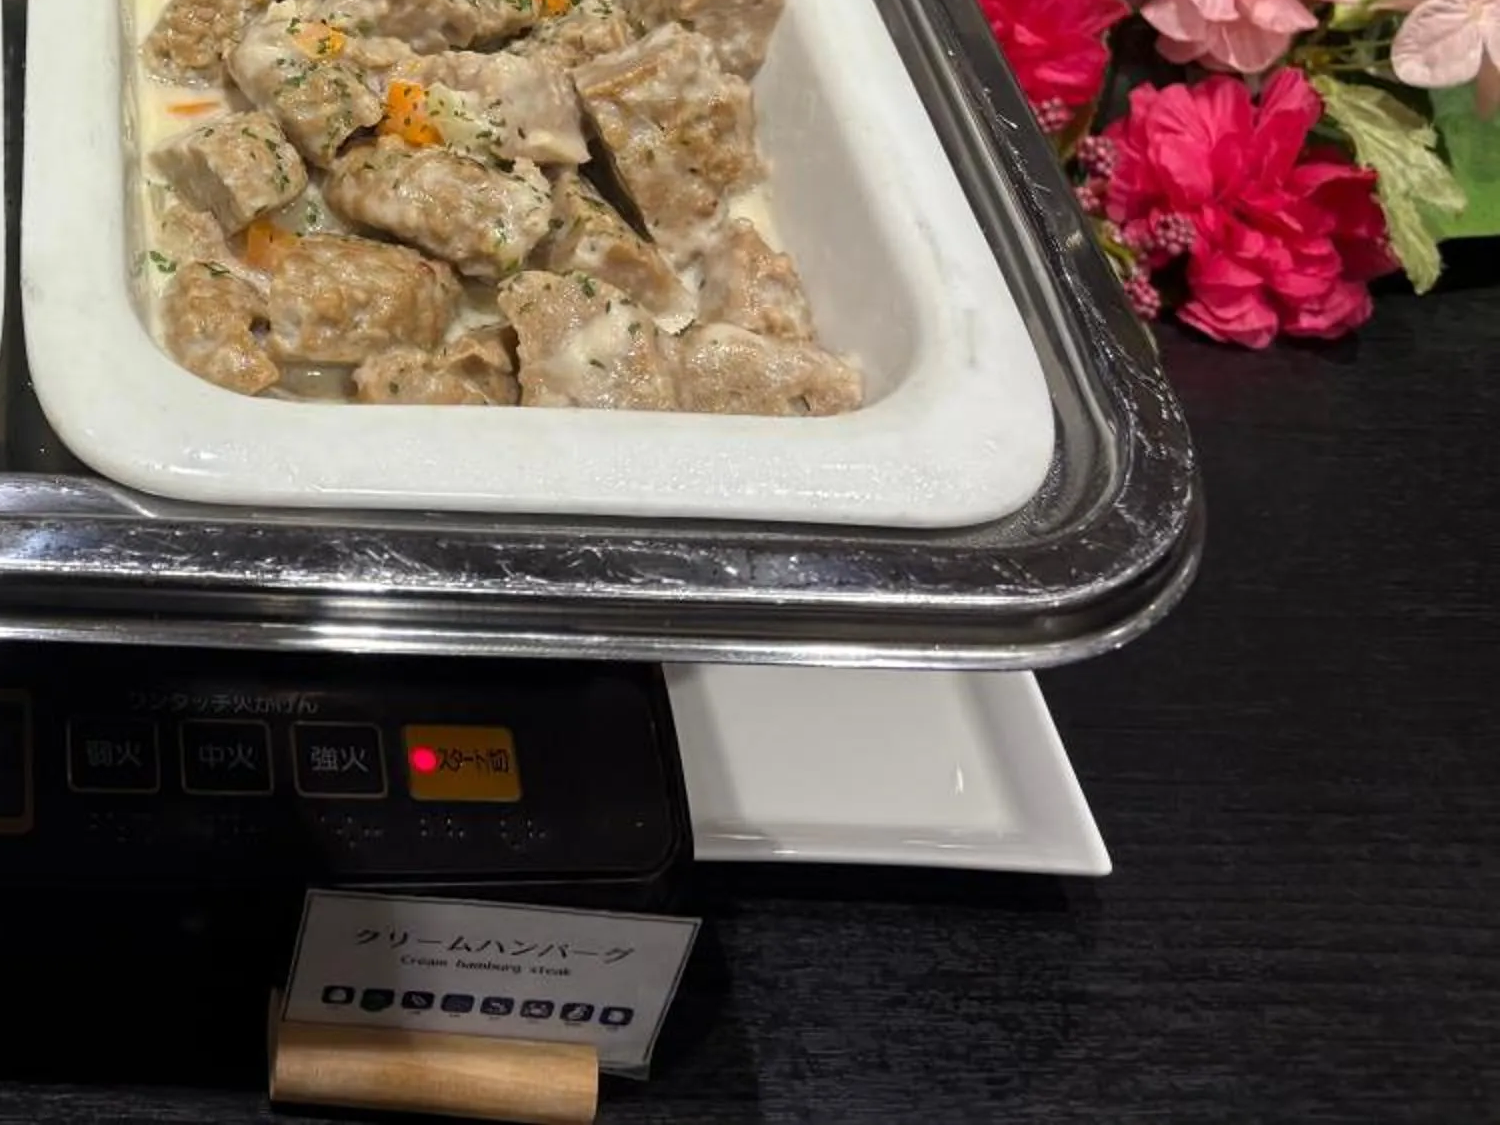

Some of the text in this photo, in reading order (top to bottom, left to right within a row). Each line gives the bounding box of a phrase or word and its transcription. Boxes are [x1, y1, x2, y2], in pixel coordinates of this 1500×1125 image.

[198, 742, 257, 770] 中火
[310, 746, 369, 773] 強火
[355, 928, 635, 965] クリームハンバーグ
[400, 954, 572, 977] Cream hamburg steak
